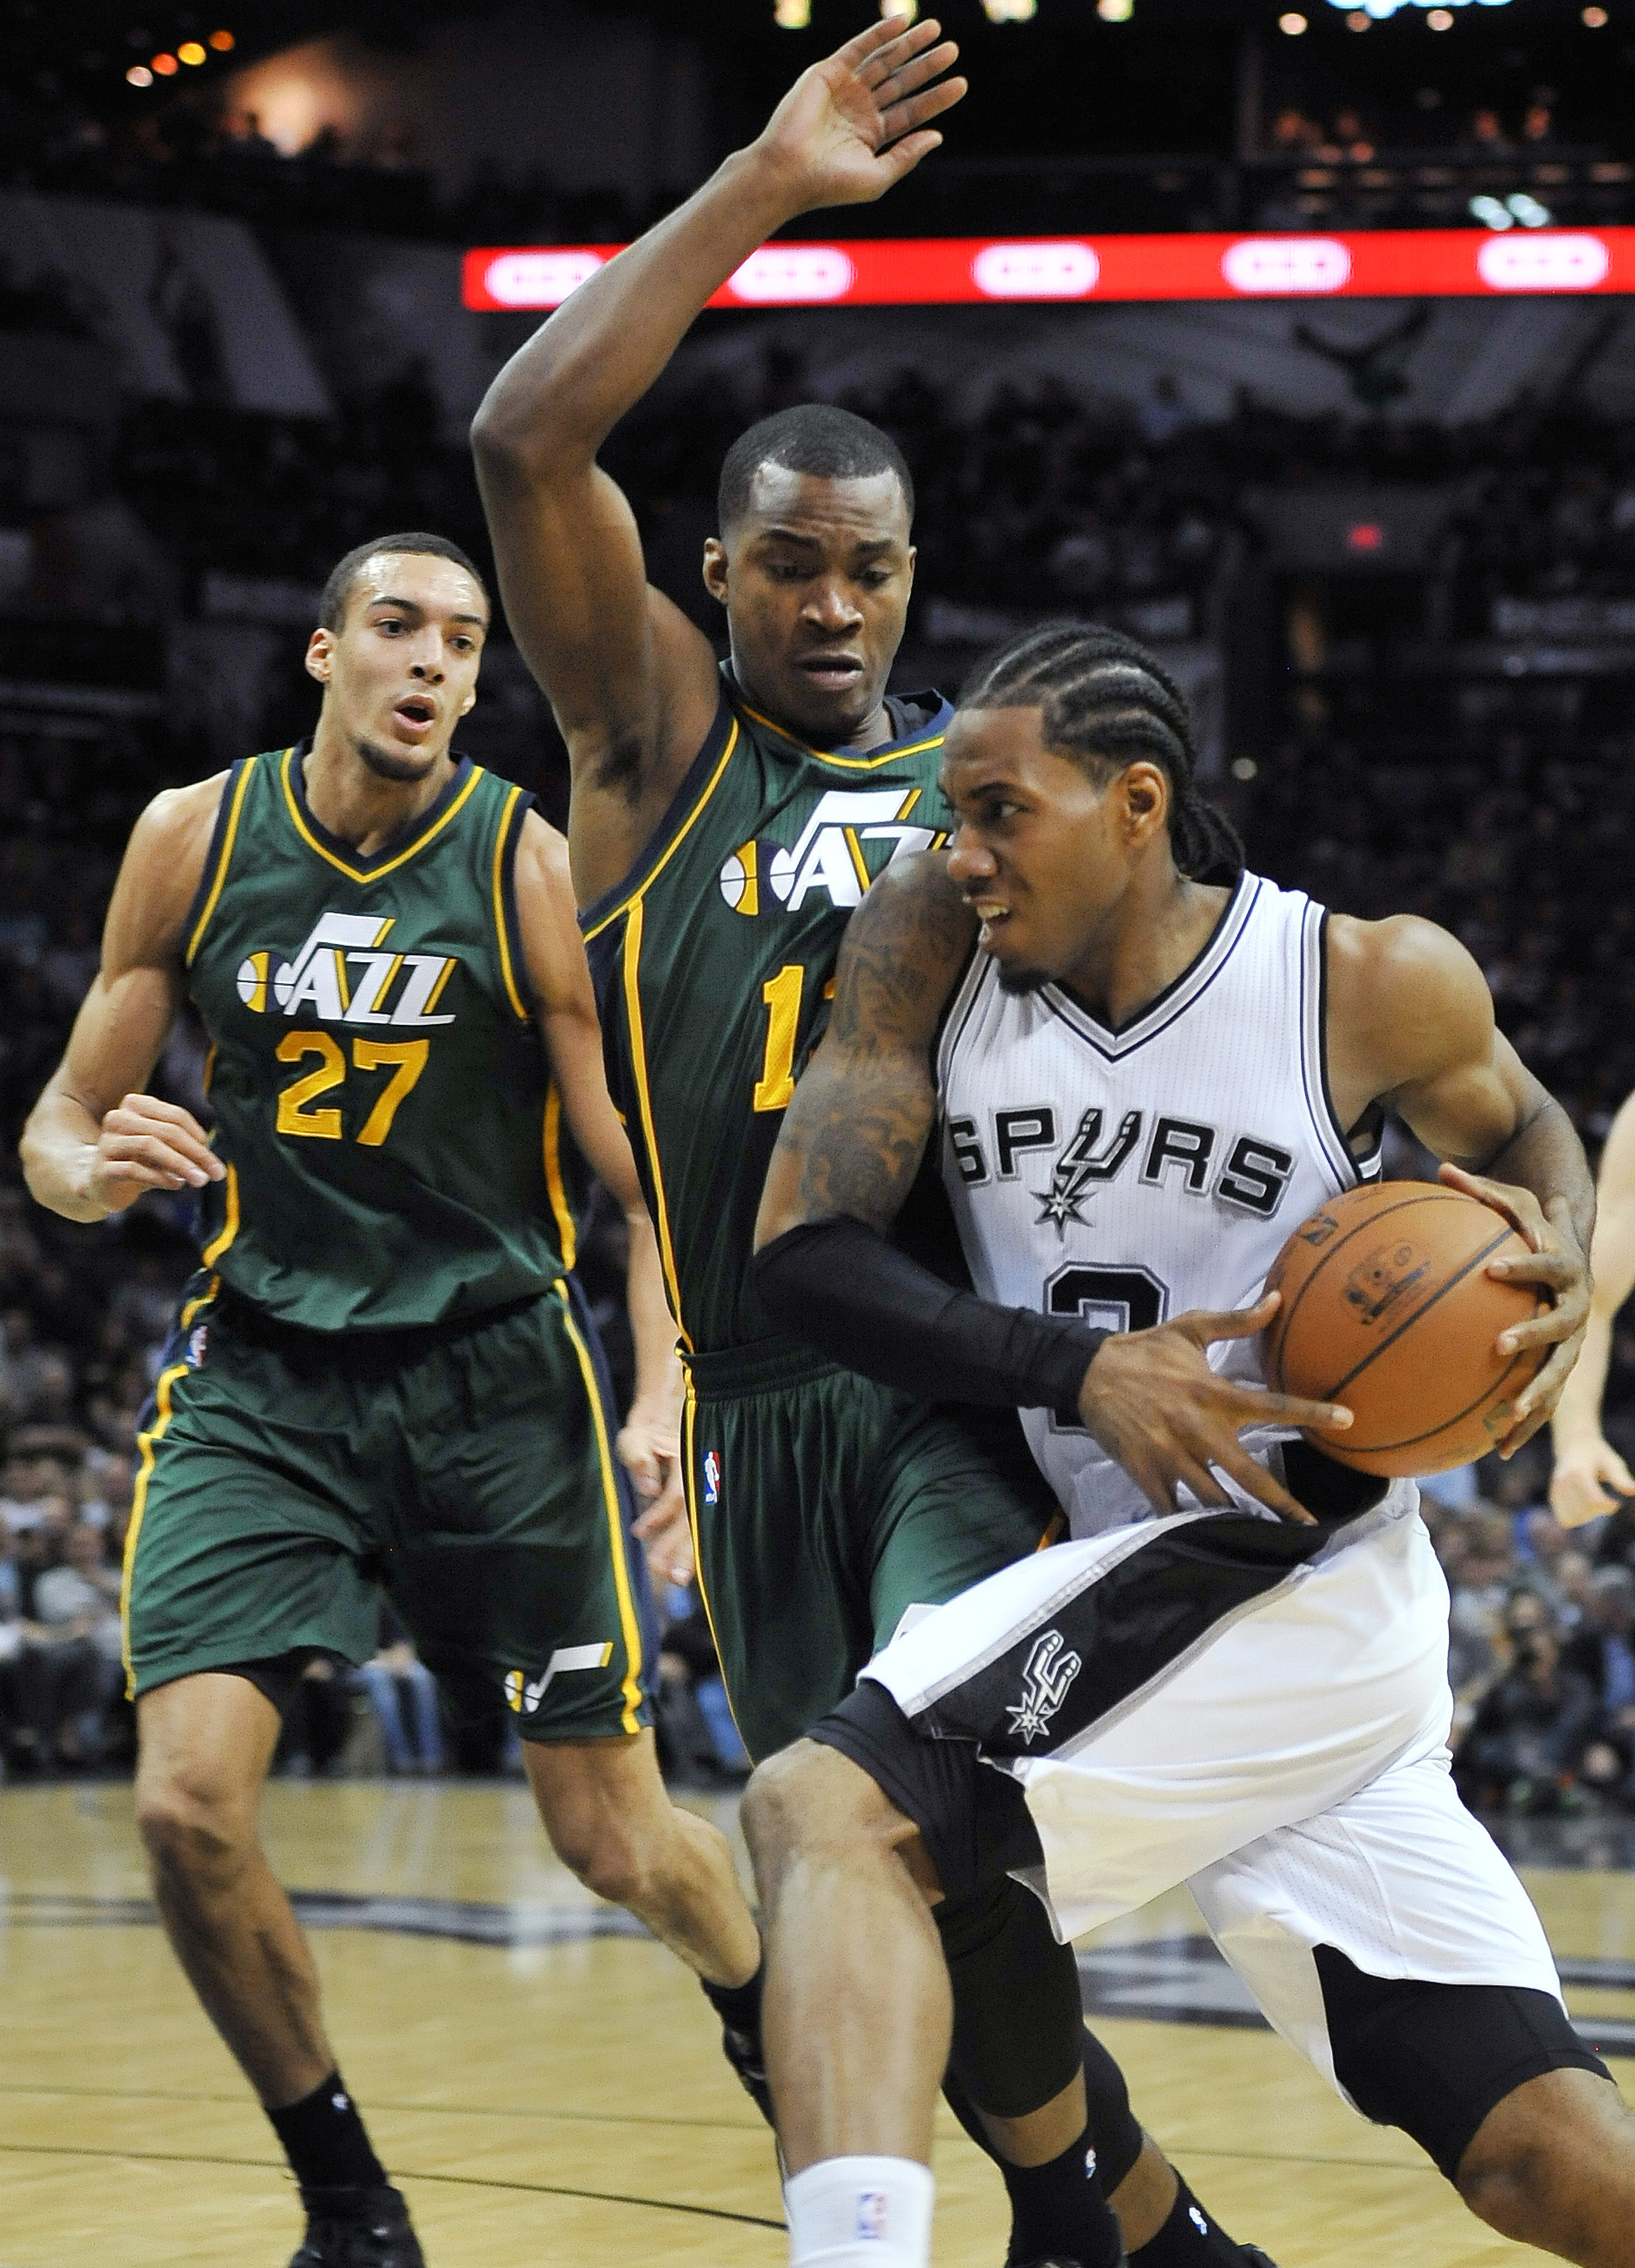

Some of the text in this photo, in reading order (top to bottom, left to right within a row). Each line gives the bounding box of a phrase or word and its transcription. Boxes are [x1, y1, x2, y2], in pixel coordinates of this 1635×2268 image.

[237, 912, 457, 1027] JAZZ
[275, 1030, 430, 1147] 27
[754, 963, 836, 1114] 1
